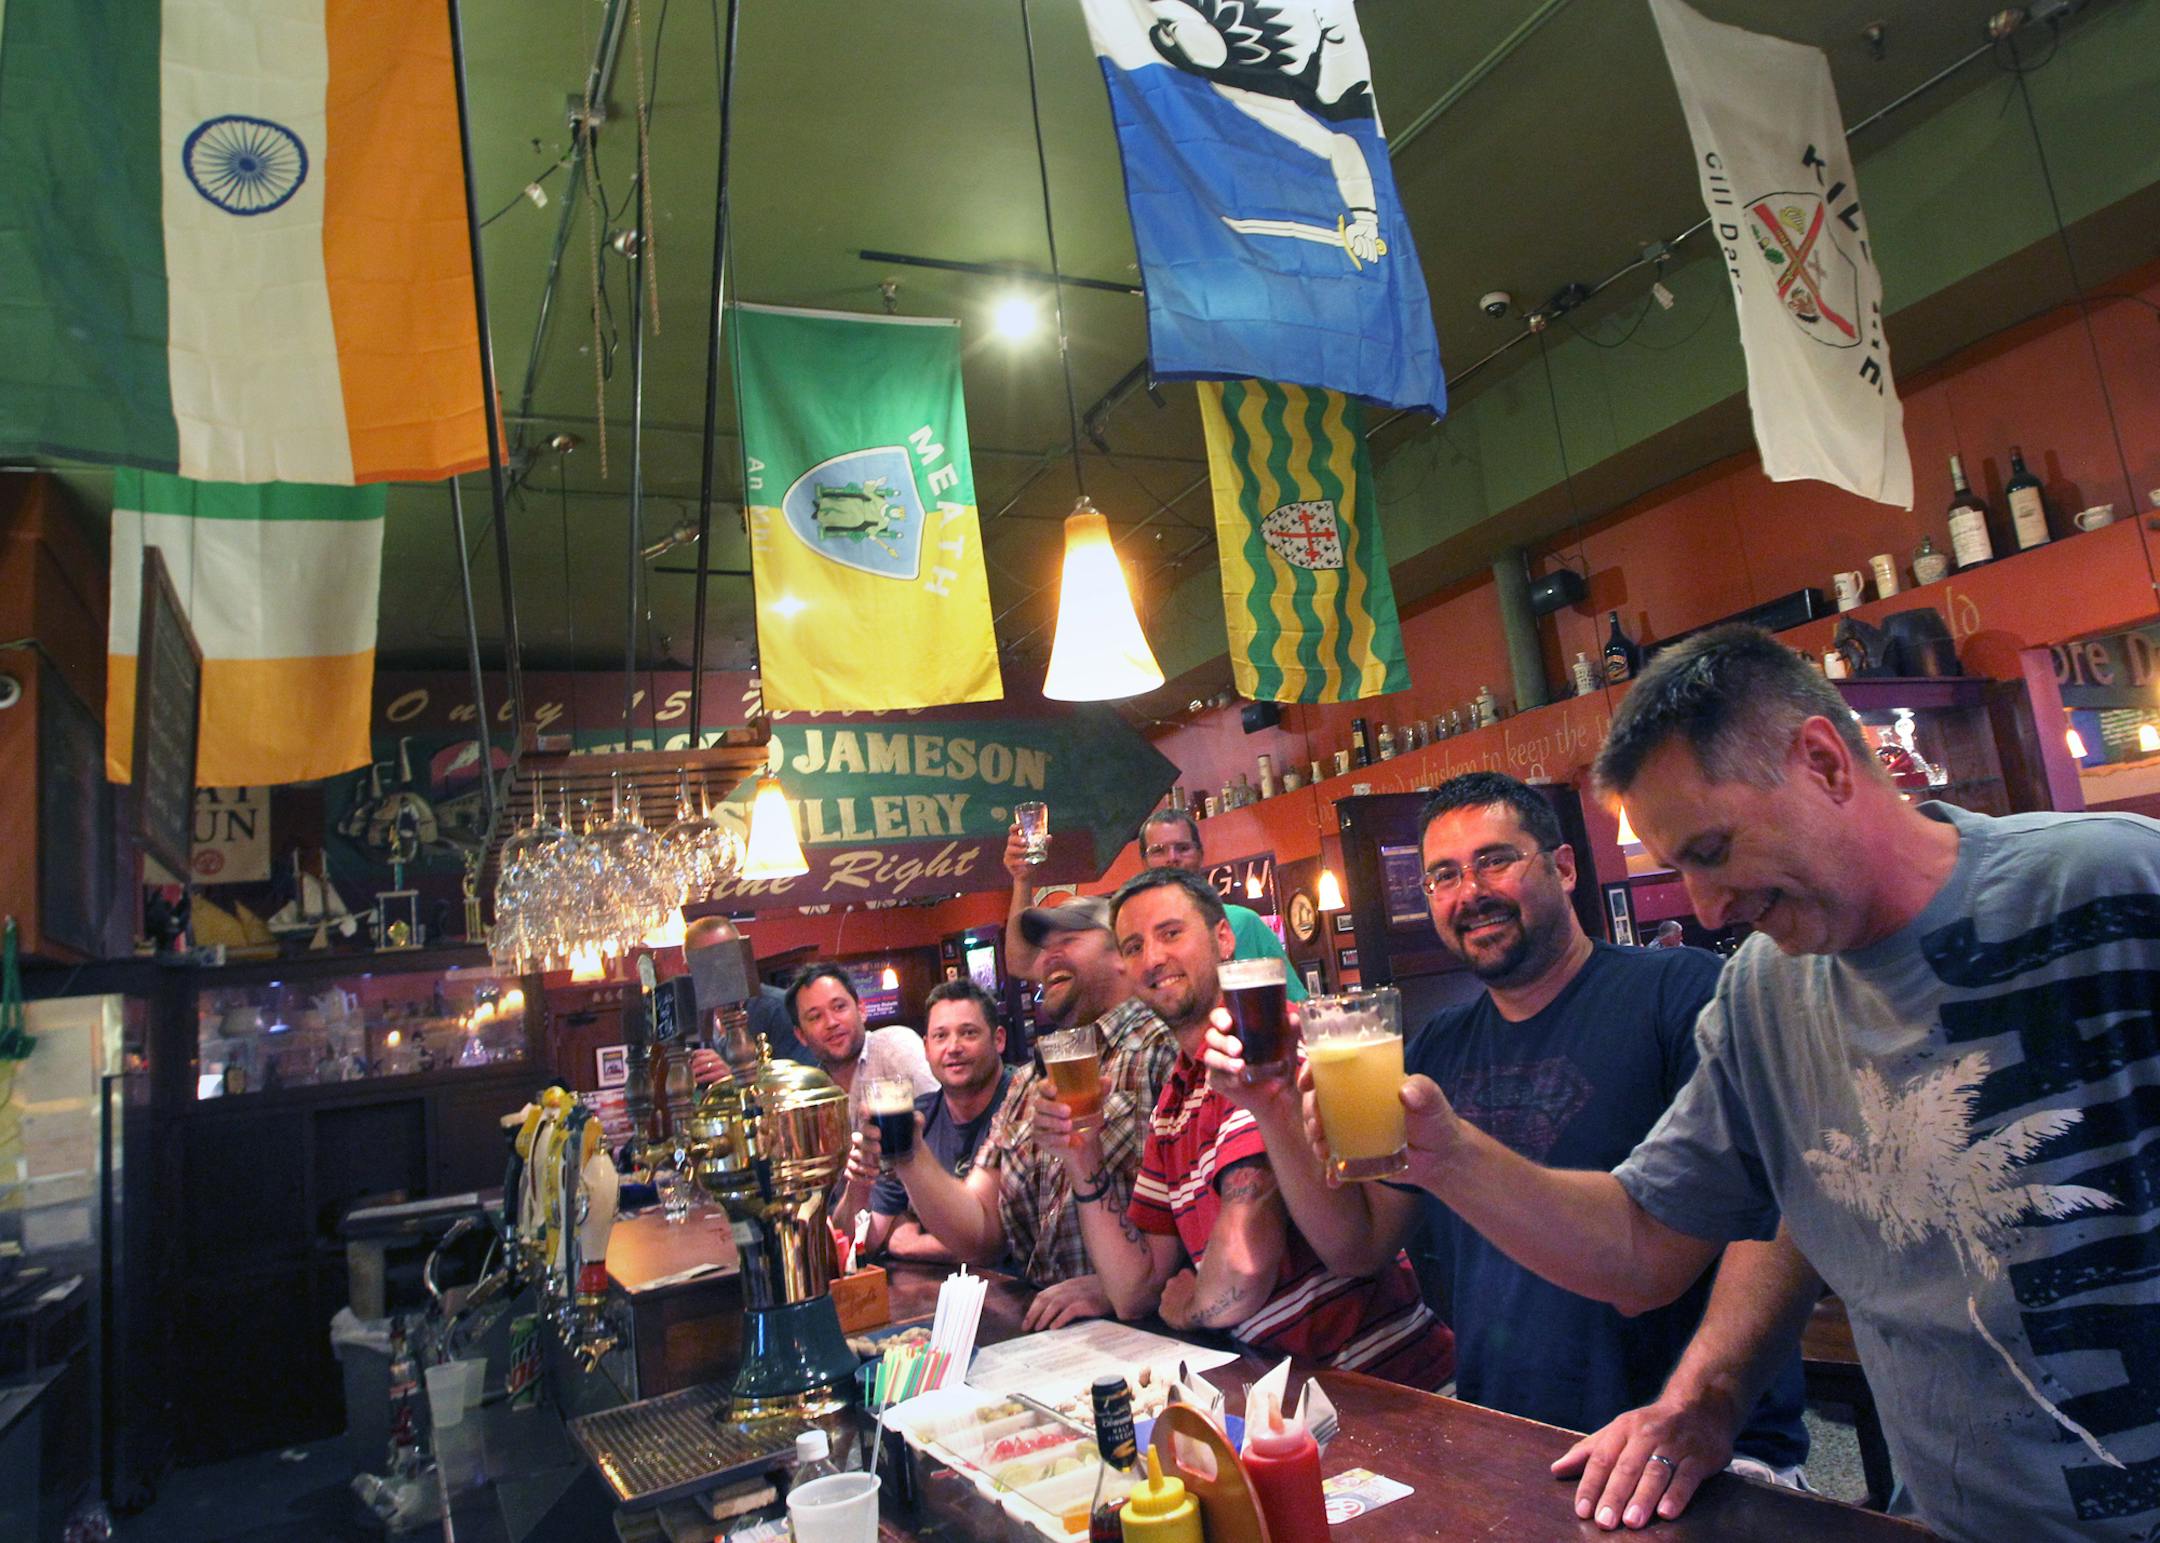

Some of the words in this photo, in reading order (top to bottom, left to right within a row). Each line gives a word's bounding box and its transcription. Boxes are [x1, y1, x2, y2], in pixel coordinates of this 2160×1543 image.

[1705, 152, 1733, 206] Cill
[748, 456, 765, 490] An
[908, 424, 964, 597] MEATH
[792, 729, 1052, 790] JAMESON
[1504, 728, 1550, 769] keep
[1555, 710, 1588, 758] the
[822, 840, 980, 895] Right
